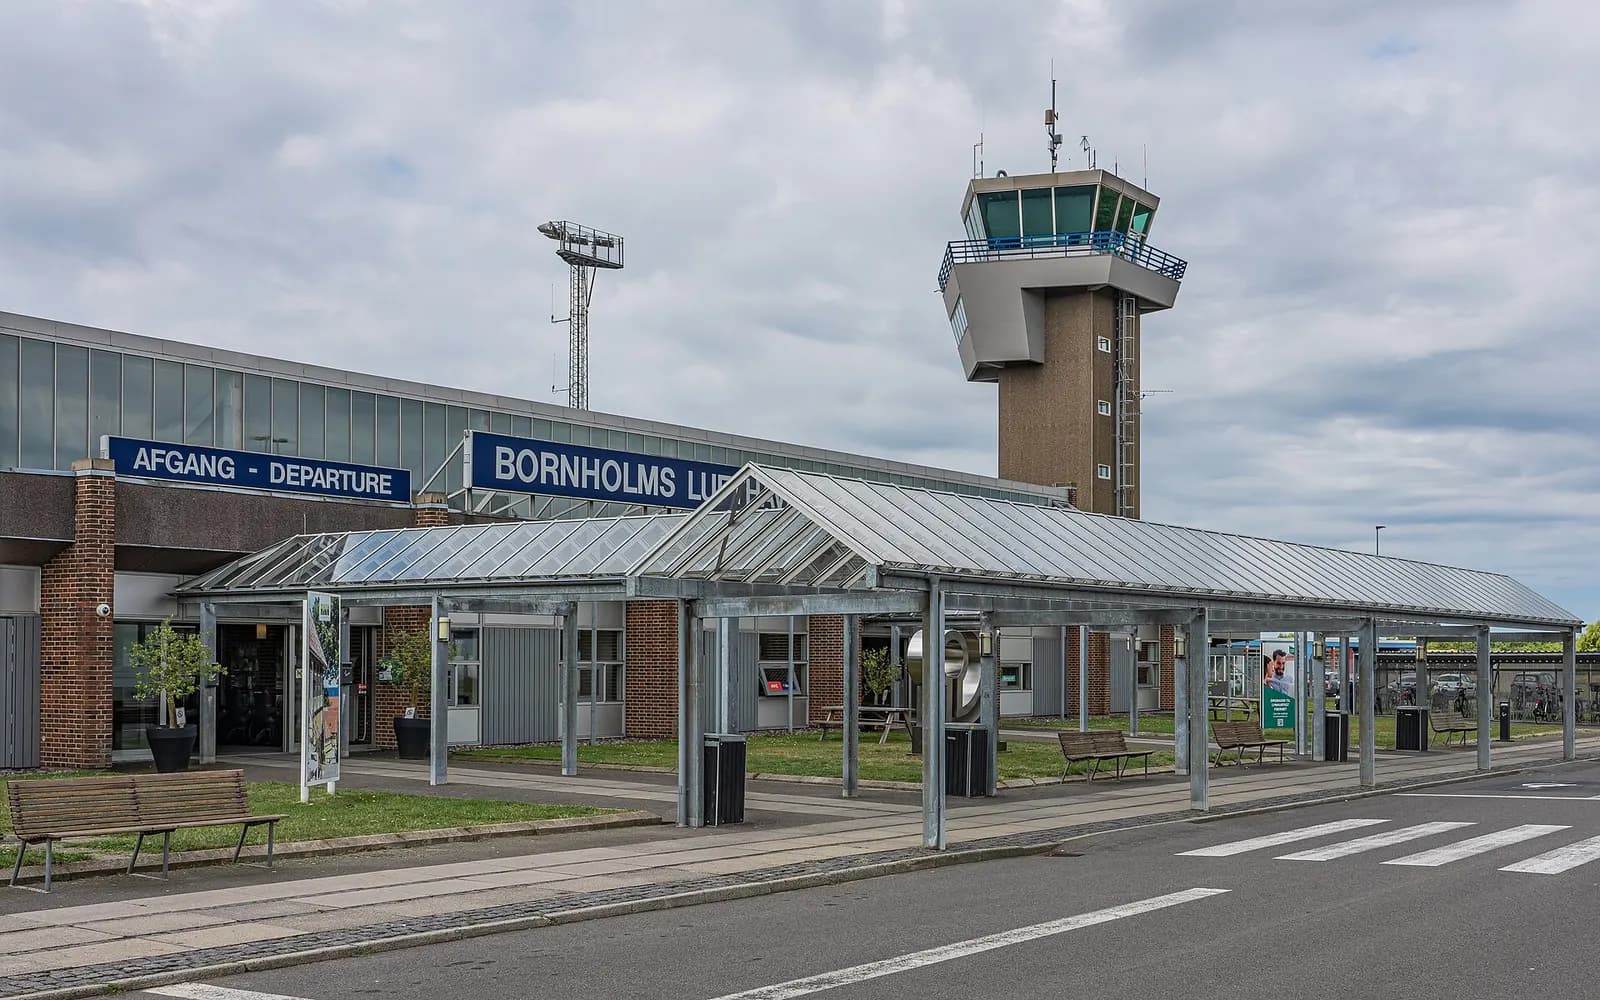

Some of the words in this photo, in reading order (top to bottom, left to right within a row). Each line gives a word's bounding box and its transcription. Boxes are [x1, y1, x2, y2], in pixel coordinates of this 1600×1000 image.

[133, 447, 235, 480] AFGANG
[270, 461, 392, 495] DEPARTURE
[495, 445, 676, 498] BORNHOLMS
